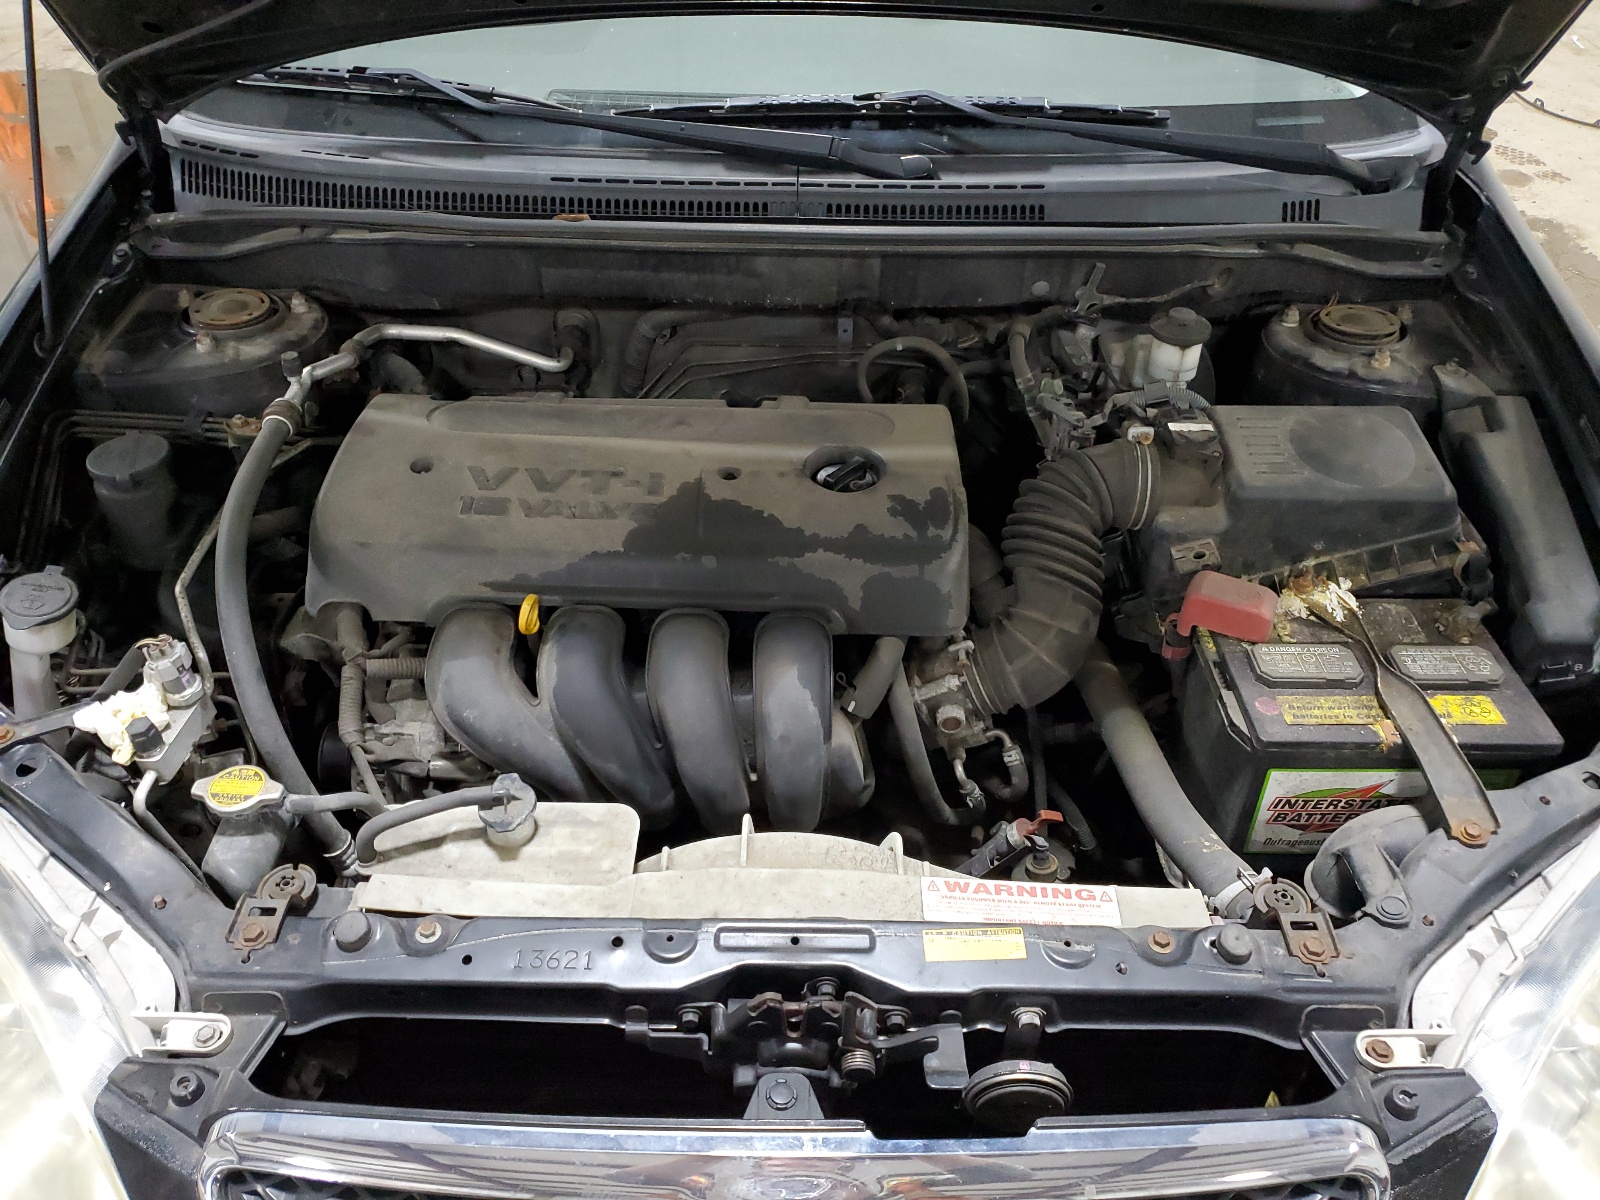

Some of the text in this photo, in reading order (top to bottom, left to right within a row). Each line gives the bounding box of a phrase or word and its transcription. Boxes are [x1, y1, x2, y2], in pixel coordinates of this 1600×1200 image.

[1292, 712, 1340, 720] batteries
[1343, 712, 1352, 720] to
[224, 773, 261, 782] CAUTION
[943, 880, 1097, 902] WARNING
[513, 948, 592, 971] 13621
